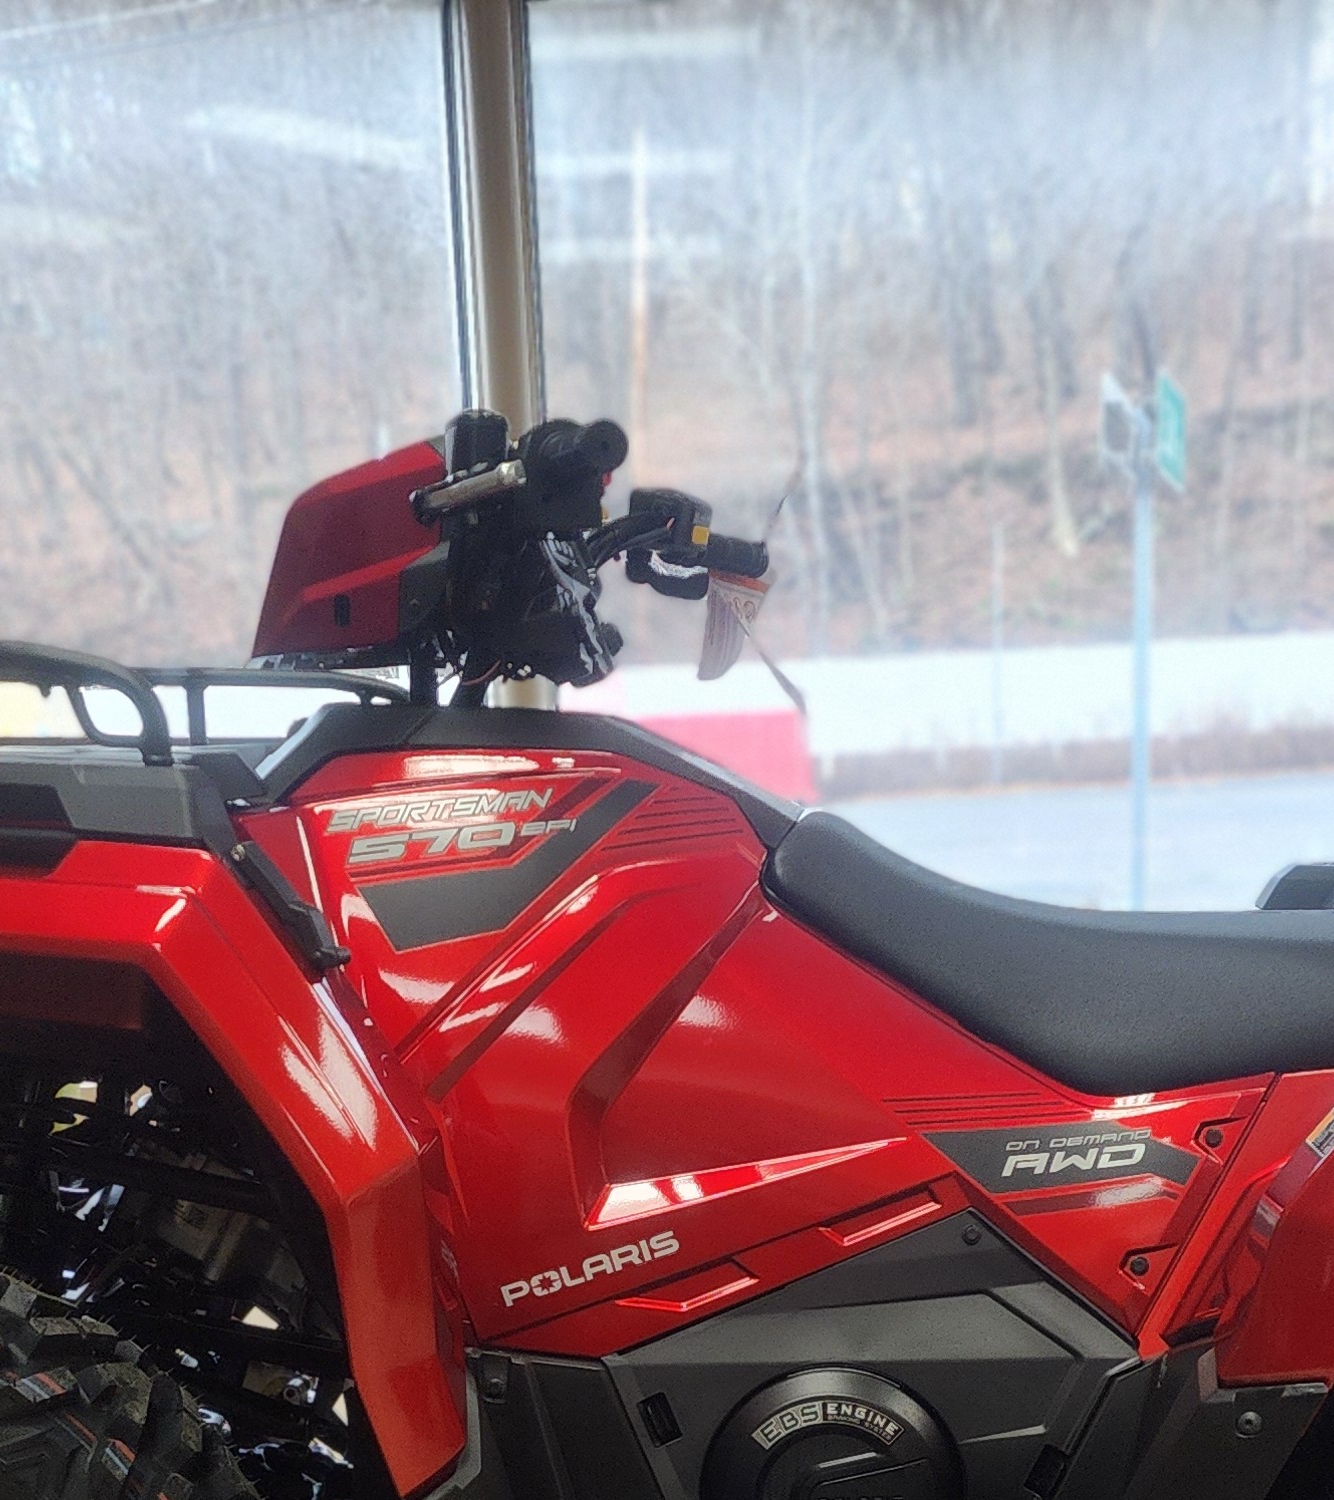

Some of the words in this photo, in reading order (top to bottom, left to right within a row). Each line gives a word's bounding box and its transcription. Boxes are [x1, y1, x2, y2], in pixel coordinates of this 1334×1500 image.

[327, 788, 554, 834] SPORTSMAN
[347, 821, 516, 865] 570
[1001, 1143, 1146, 1178] AWD
[1005, 1139, 1040, 1151] ON
[1049, 1128, 1152, 1149] DEMAND
[500, 1230, 680, 1308] POLARIS
[760, 1404, 820, 1444] EBS
[826, 1402, 900, 1436] ENGINE
